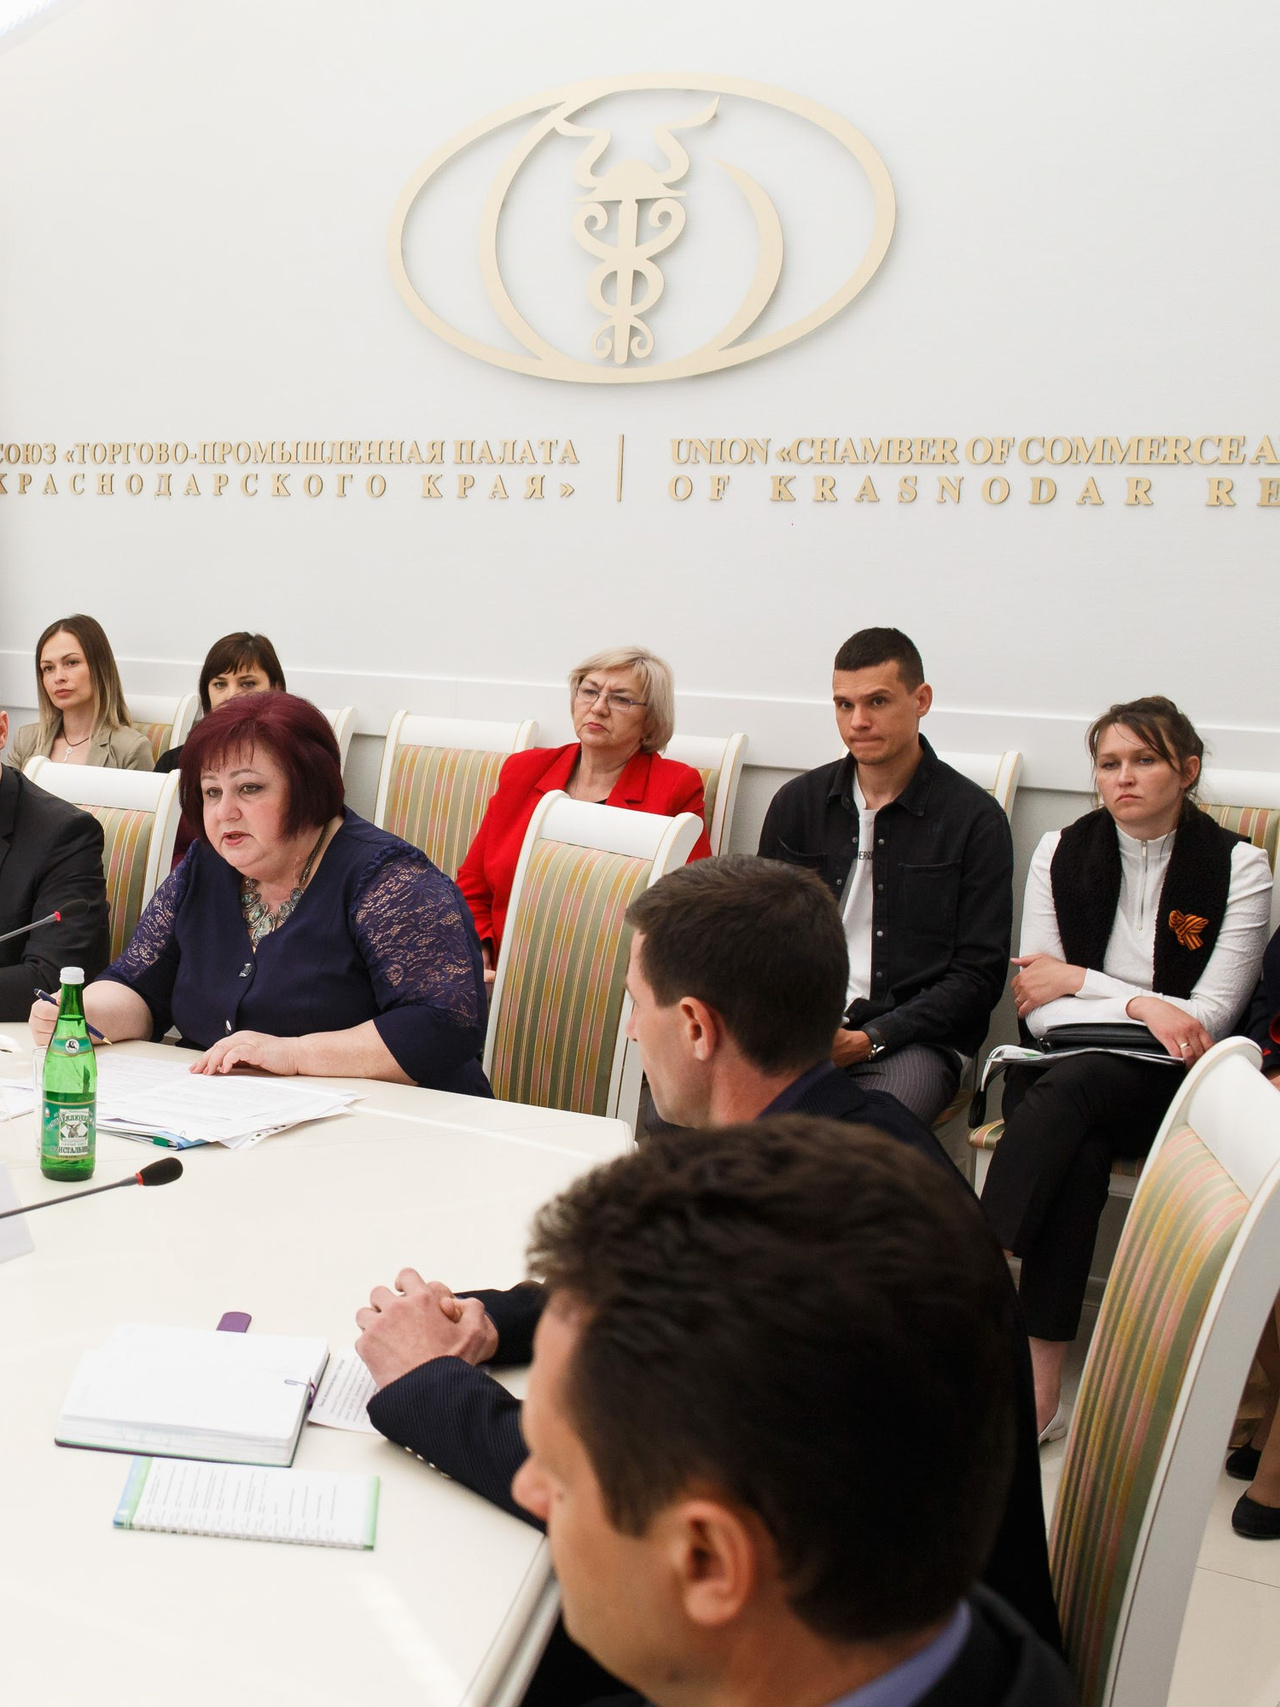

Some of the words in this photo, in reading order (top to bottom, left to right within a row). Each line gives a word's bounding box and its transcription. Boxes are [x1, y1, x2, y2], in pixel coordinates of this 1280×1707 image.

[64, 440, 445, 465] «ТОРГОВО-ПРОМЫШЛЕННАЯ
[453, 439, 580, 465] ПАЛАТА
[671, 438, 771, 465] UNION
[775, 436, 959, 465] «CHAMBER
[965, 436, 1015, 465] OF
[1019, 435, 1246, 465] COMMERCE
[421, 474, 575, 499] КРАЯ»
[669, 475, 730, 501] OF
[770, 475, 1154, 506] KRASNODAR
